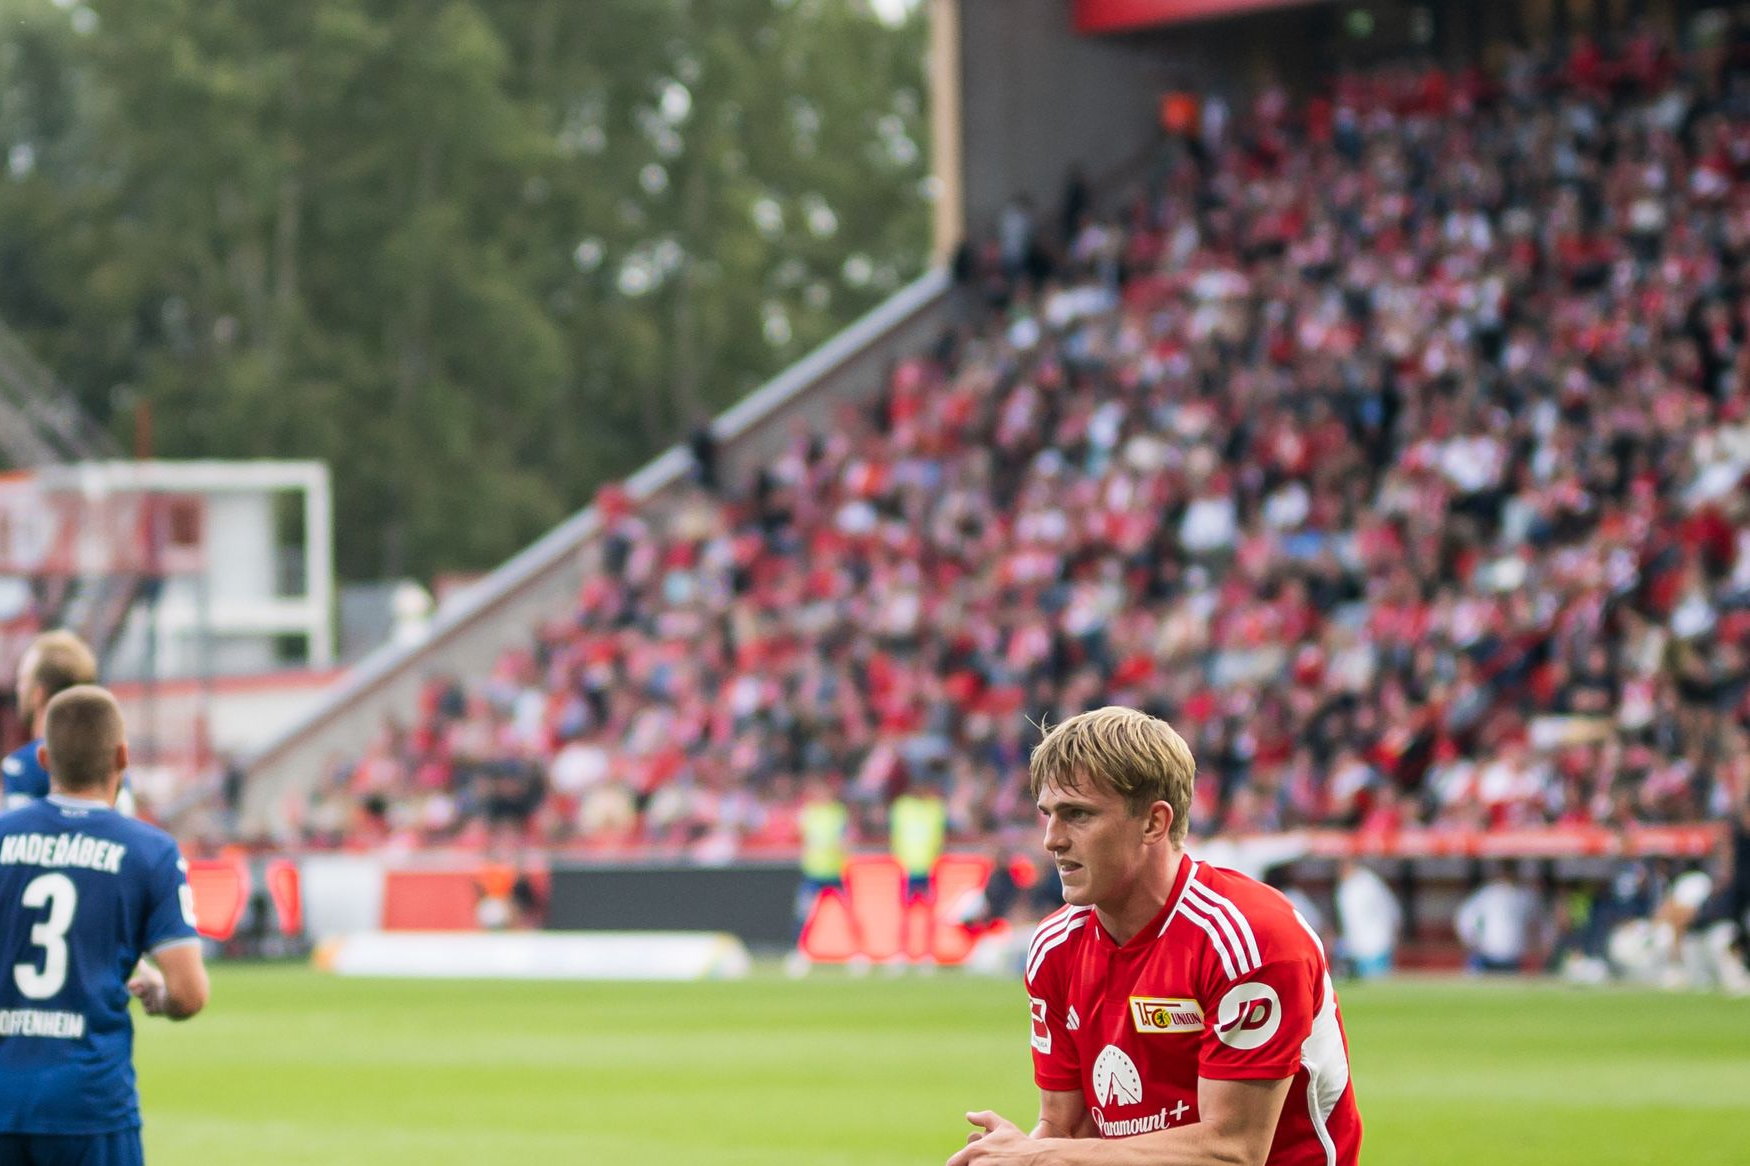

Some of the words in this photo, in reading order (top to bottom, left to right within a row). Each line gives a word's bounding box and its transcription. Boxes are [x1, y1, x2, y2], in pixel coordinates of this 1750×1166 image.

[13, 872, 77, 1000] 3
[1172, 1011, 1202, 1026] UNION
[1220, 998, 1273, 1033] JD
[1091, 1099, 1190, 1138] Paramount+
